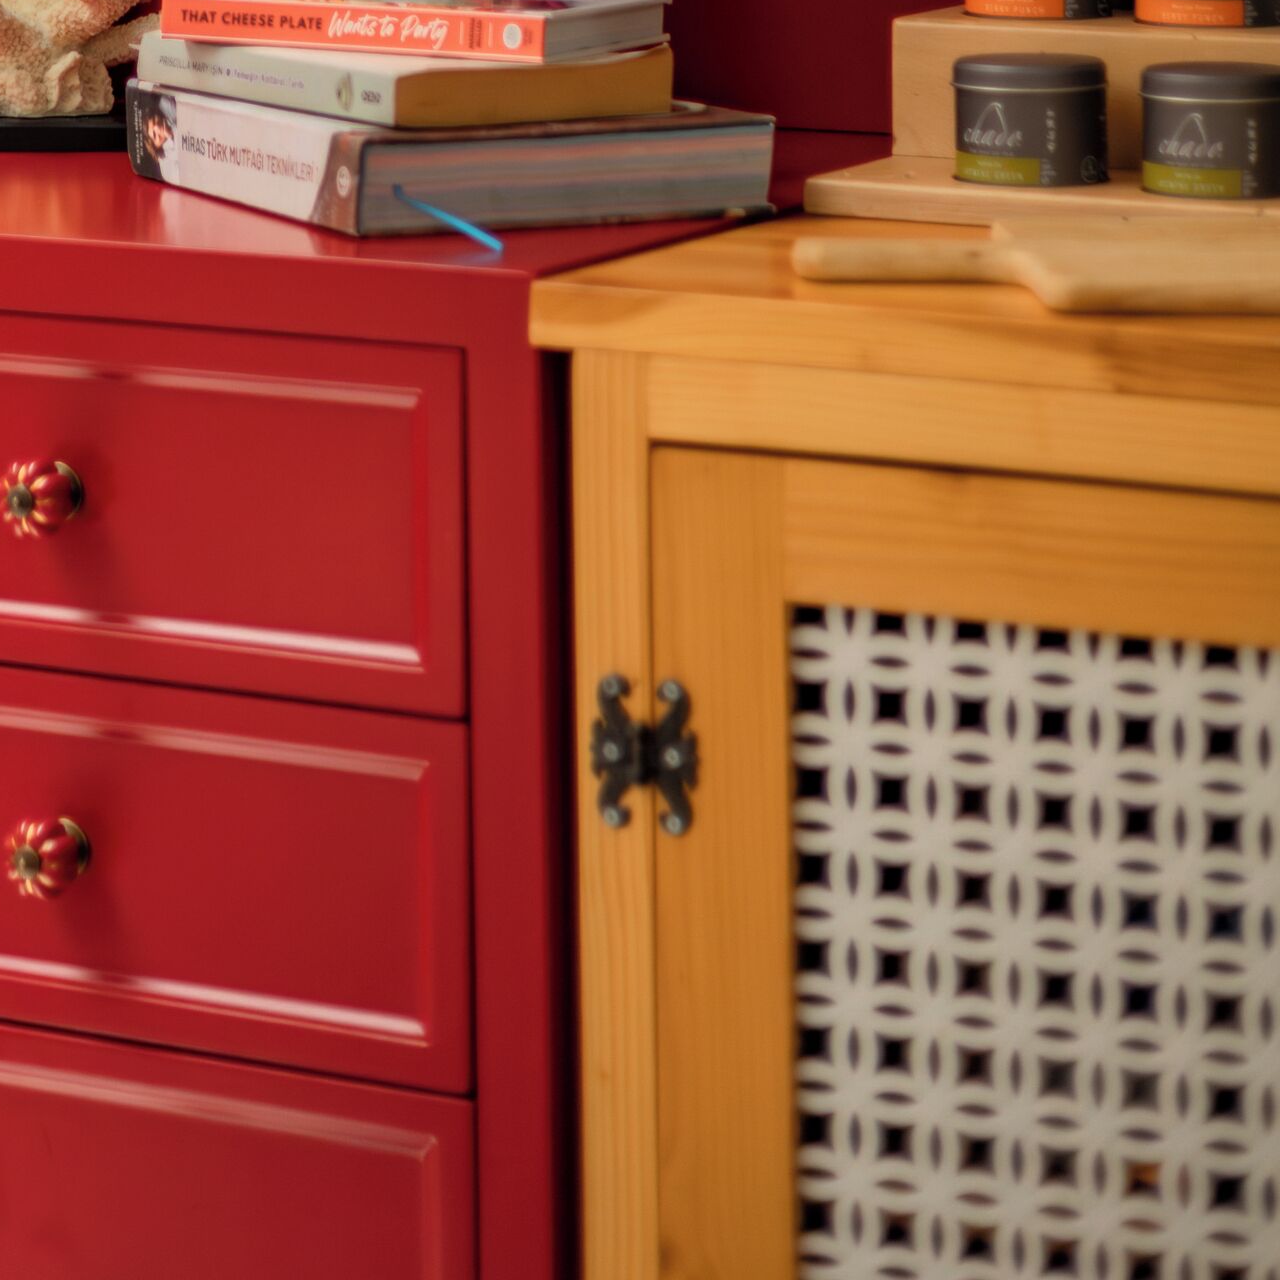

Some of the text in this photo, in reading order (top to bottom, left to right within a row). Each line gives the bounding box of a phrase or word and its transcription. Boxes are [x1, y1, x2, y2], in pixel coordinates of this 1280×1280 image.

[180, 8, 217, 24] THAT
[221, 11, 275, 28] CHEESE
[279, 15, 323, 31] PLATE
[327, 10, 378, 39] Wants
[377, 15, 399, 38] to
[399, 13, 450, 50] Party
[158, 55, 191, 71] PRISCILLA
[191, 61, 209, 74] MARY
[181, 131, 315, 183] MİRAS TÜRK MUTFAĞI TEKNİKLERİ
